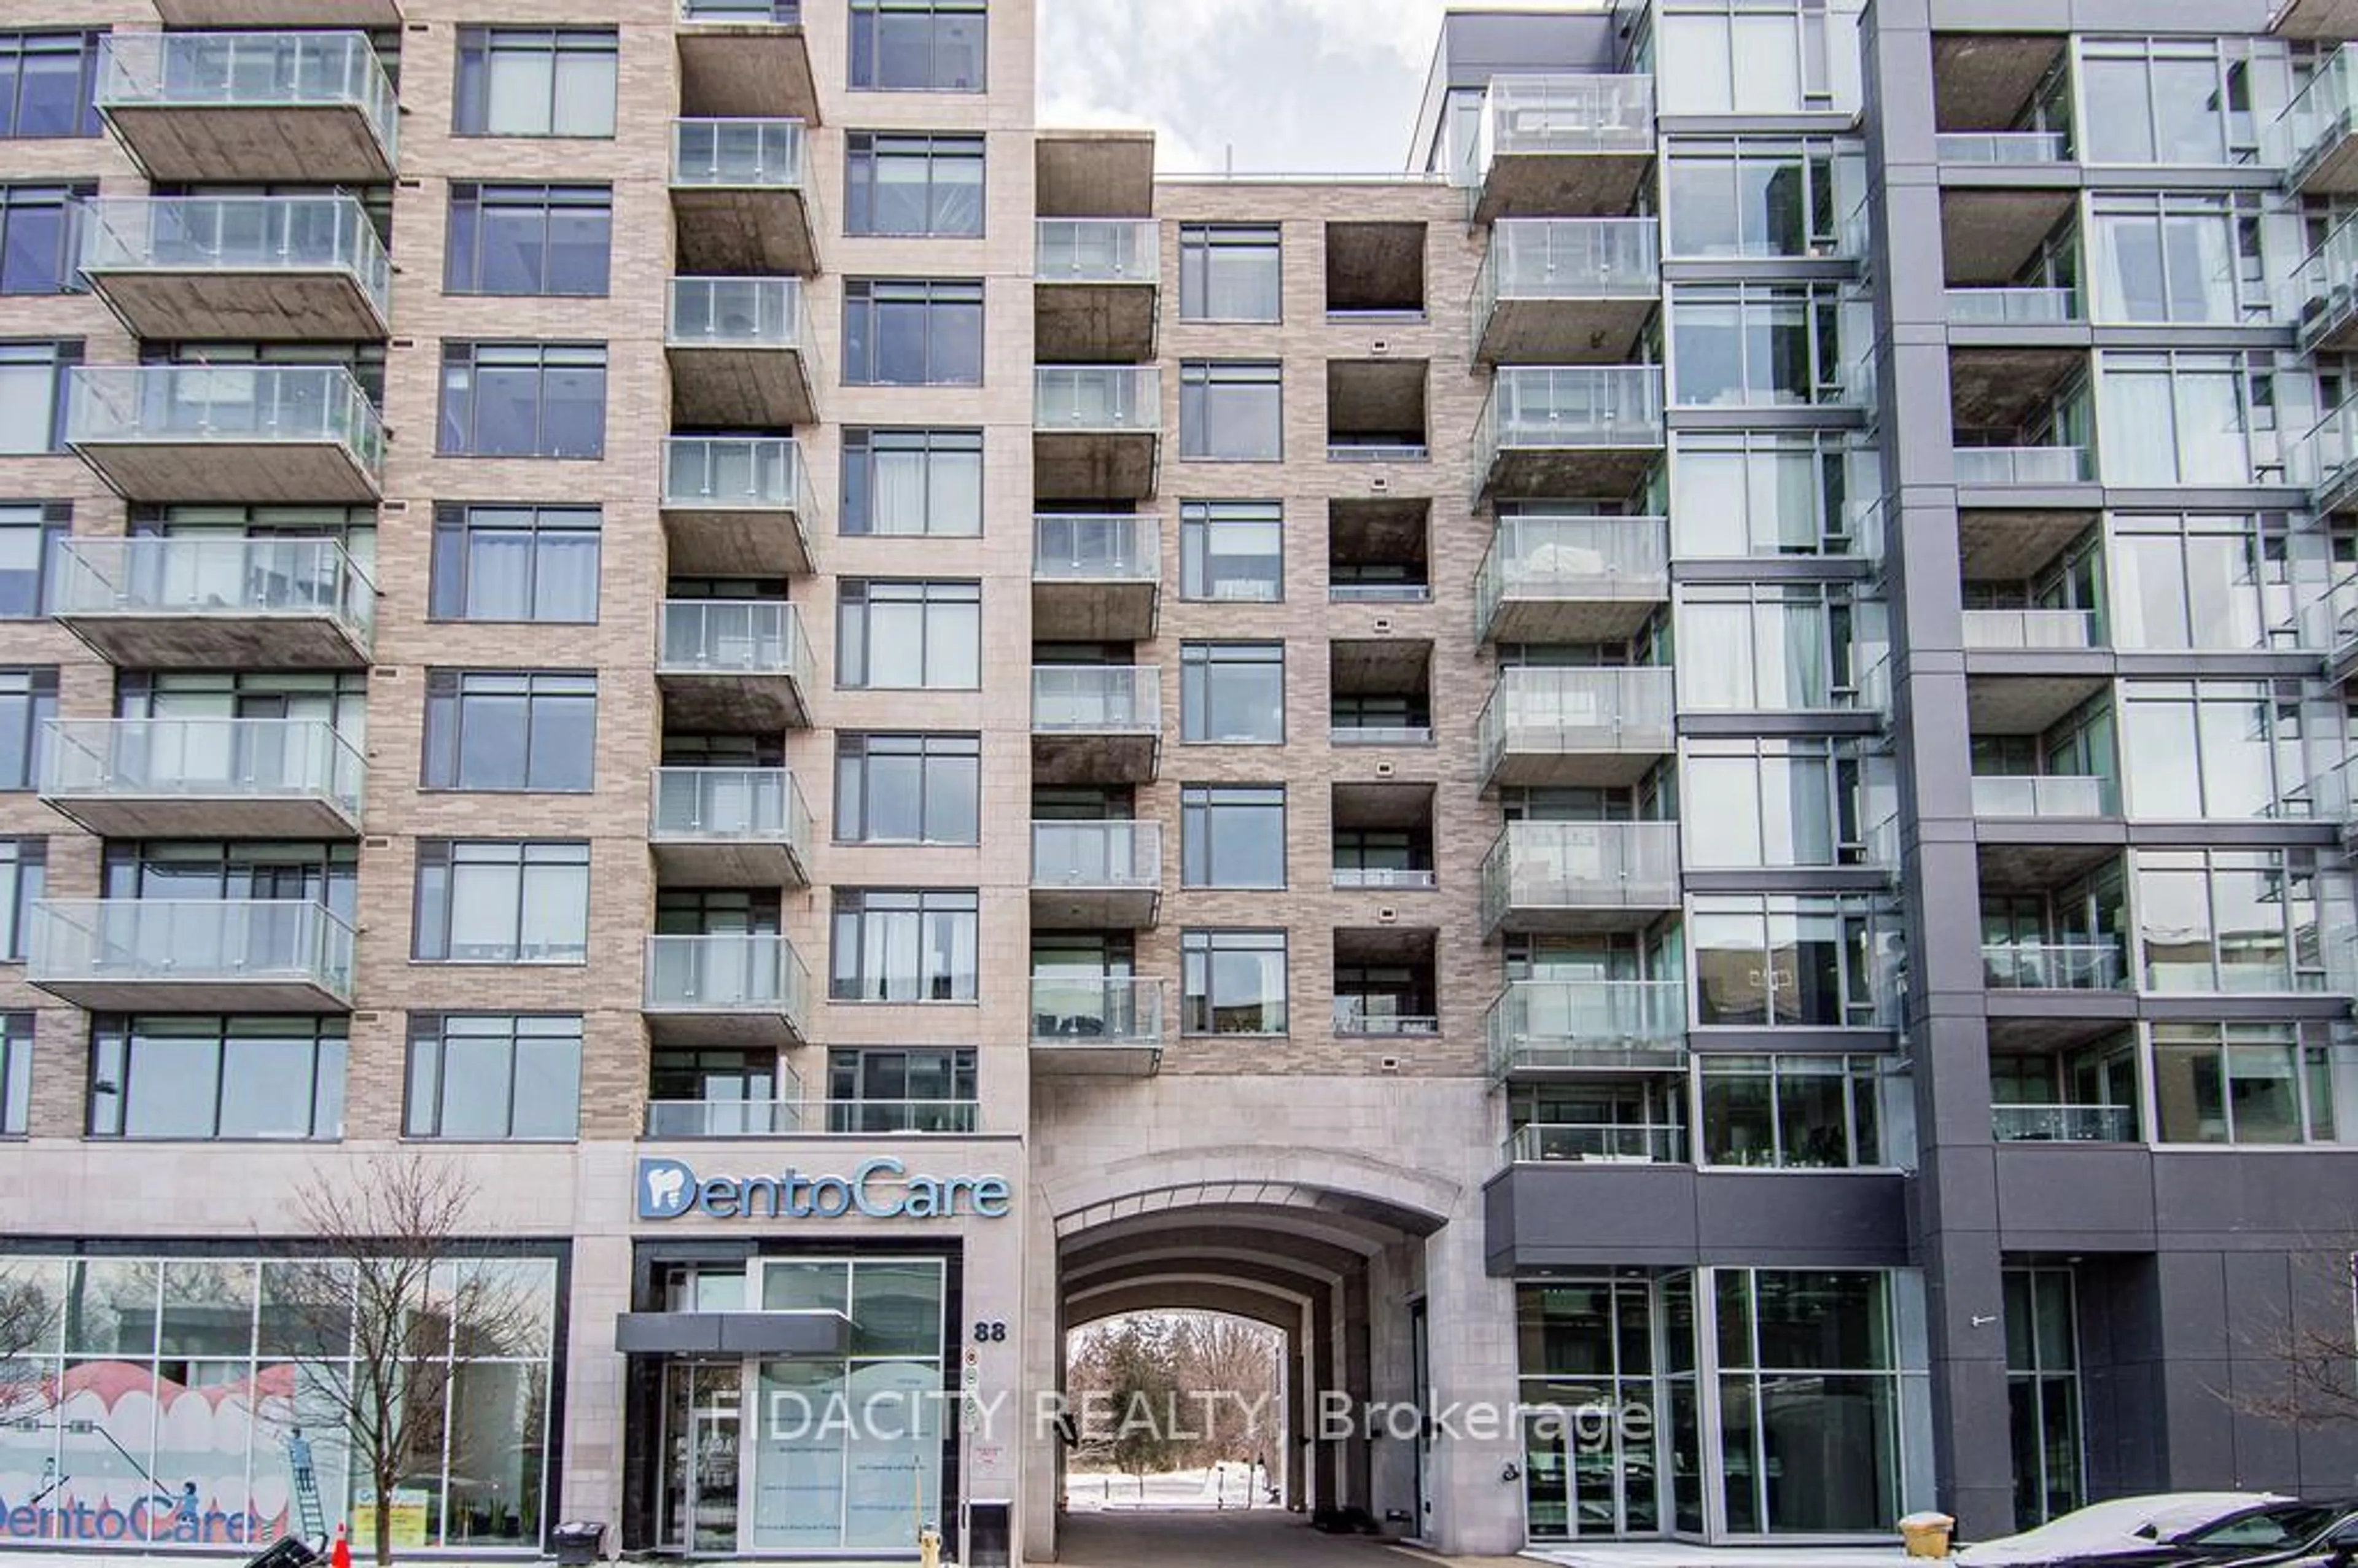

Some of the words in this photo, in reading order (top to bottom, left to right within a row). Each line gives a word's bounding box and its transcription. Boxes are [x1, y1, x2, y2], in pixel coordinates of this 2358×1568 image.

[639, 1155, 1011, 1219] DentoCare
[974, 1321, 1006, 1343] 88
[0, 1494, 255, 1543] entoCare
